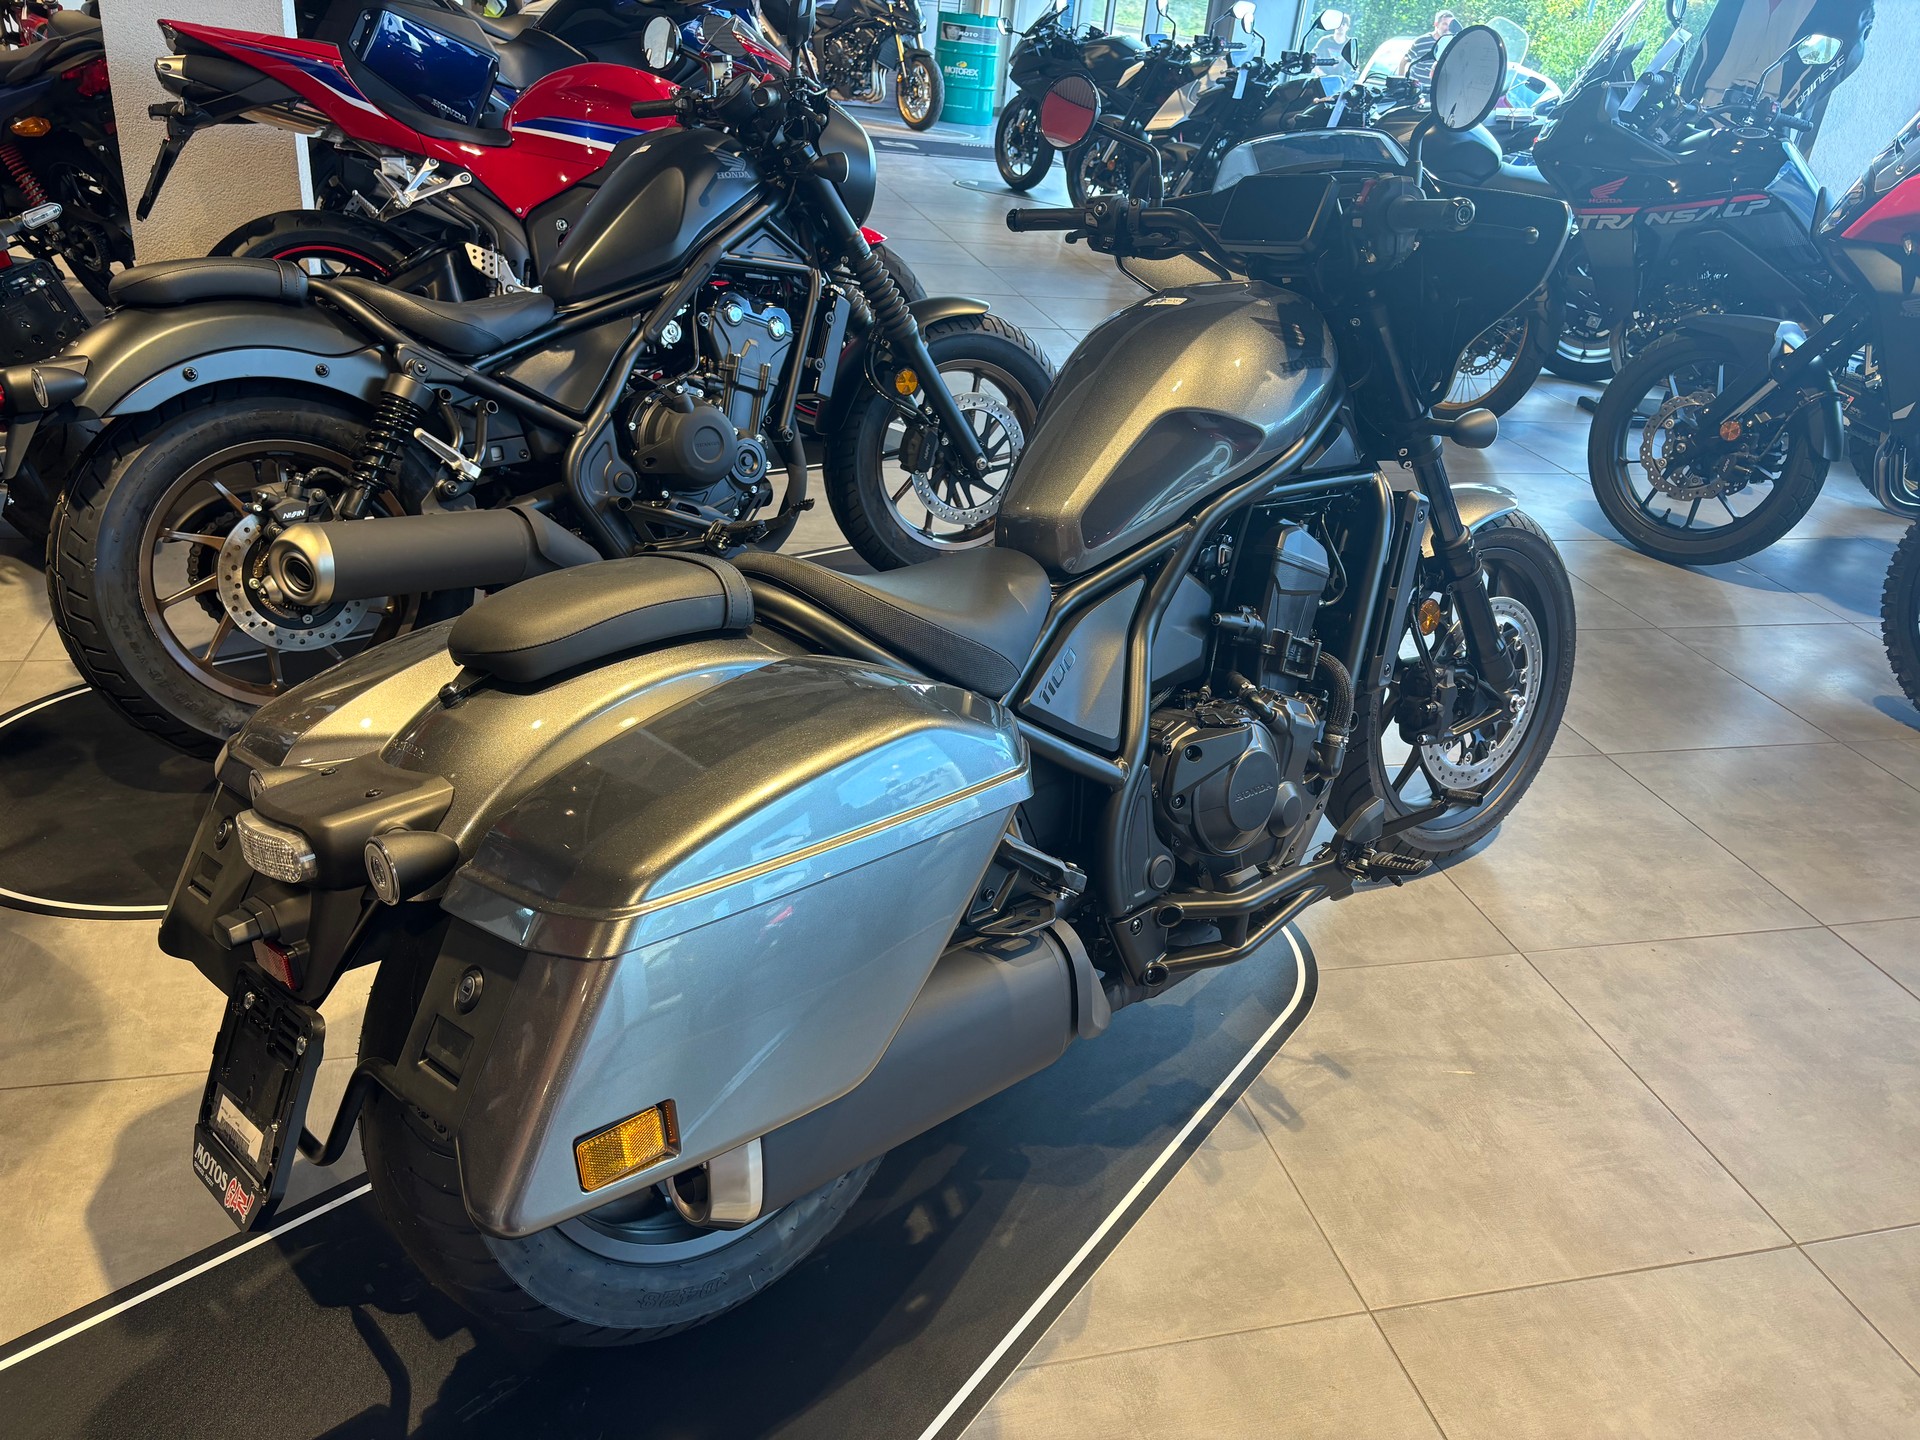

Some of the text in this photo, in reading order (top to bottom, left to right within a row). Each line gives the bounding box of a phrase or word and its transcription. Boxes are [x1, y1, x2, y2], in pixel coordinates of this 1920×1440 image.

[944, 65, 979, 77] MOTOREX
[431, 98, 468, 124] HONDA
[716, 171, 752, 179] HONDA
[1578, 198, 1771, 230] TRANSALP
[1038, 646, 1077, 705] 1100
[194, 1142, 228, 1192] MOTOS
